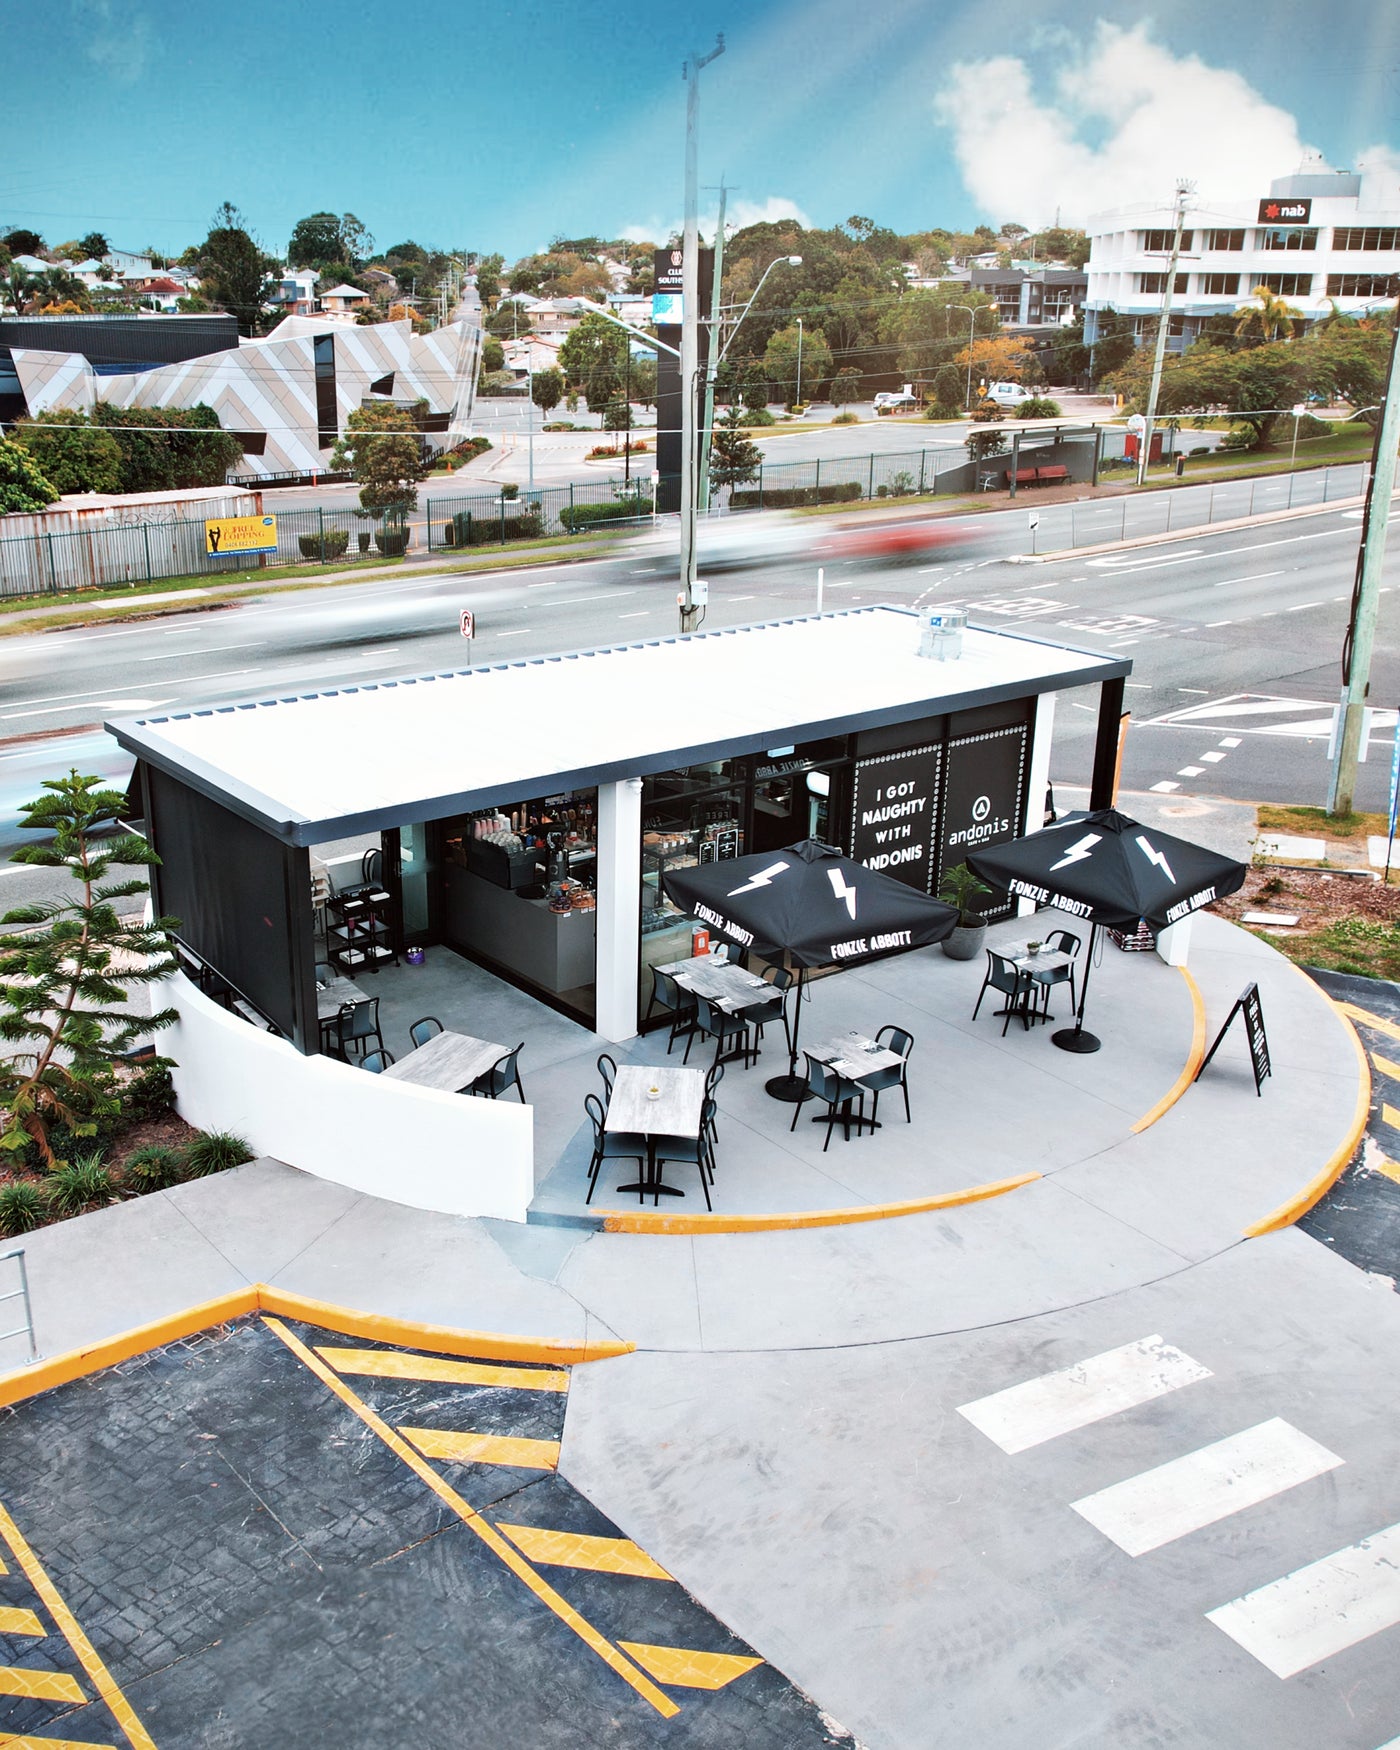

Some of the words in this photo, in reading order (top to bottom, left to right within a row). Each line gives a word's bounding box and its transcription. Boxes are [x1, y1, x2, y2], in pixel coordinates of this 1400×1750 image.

[1281, 204, 1306, 217] nab
[876, 789, 882, 802] I
[886, 781, 916, 799] GOT
[862, 797, 927, 826] NAUGHTY
[875, 824, 911, 844] WITH
[949, 817, 1009, 846] andonis
[1008, 878, 1050, 903] FONZIE
[1050, 893, 1094, 919] ABBOTT
[1166, 901, 1190, 924] FONZIE
[1189, 886, 1217, 911] ABBOTT
[693, 901, 724, 929] FONZIE
[723, 919, 755, 947] ABBOTT
[830, 938, 869, 960] FONZIE
[870, 930, 912, 950] ABBOTT
